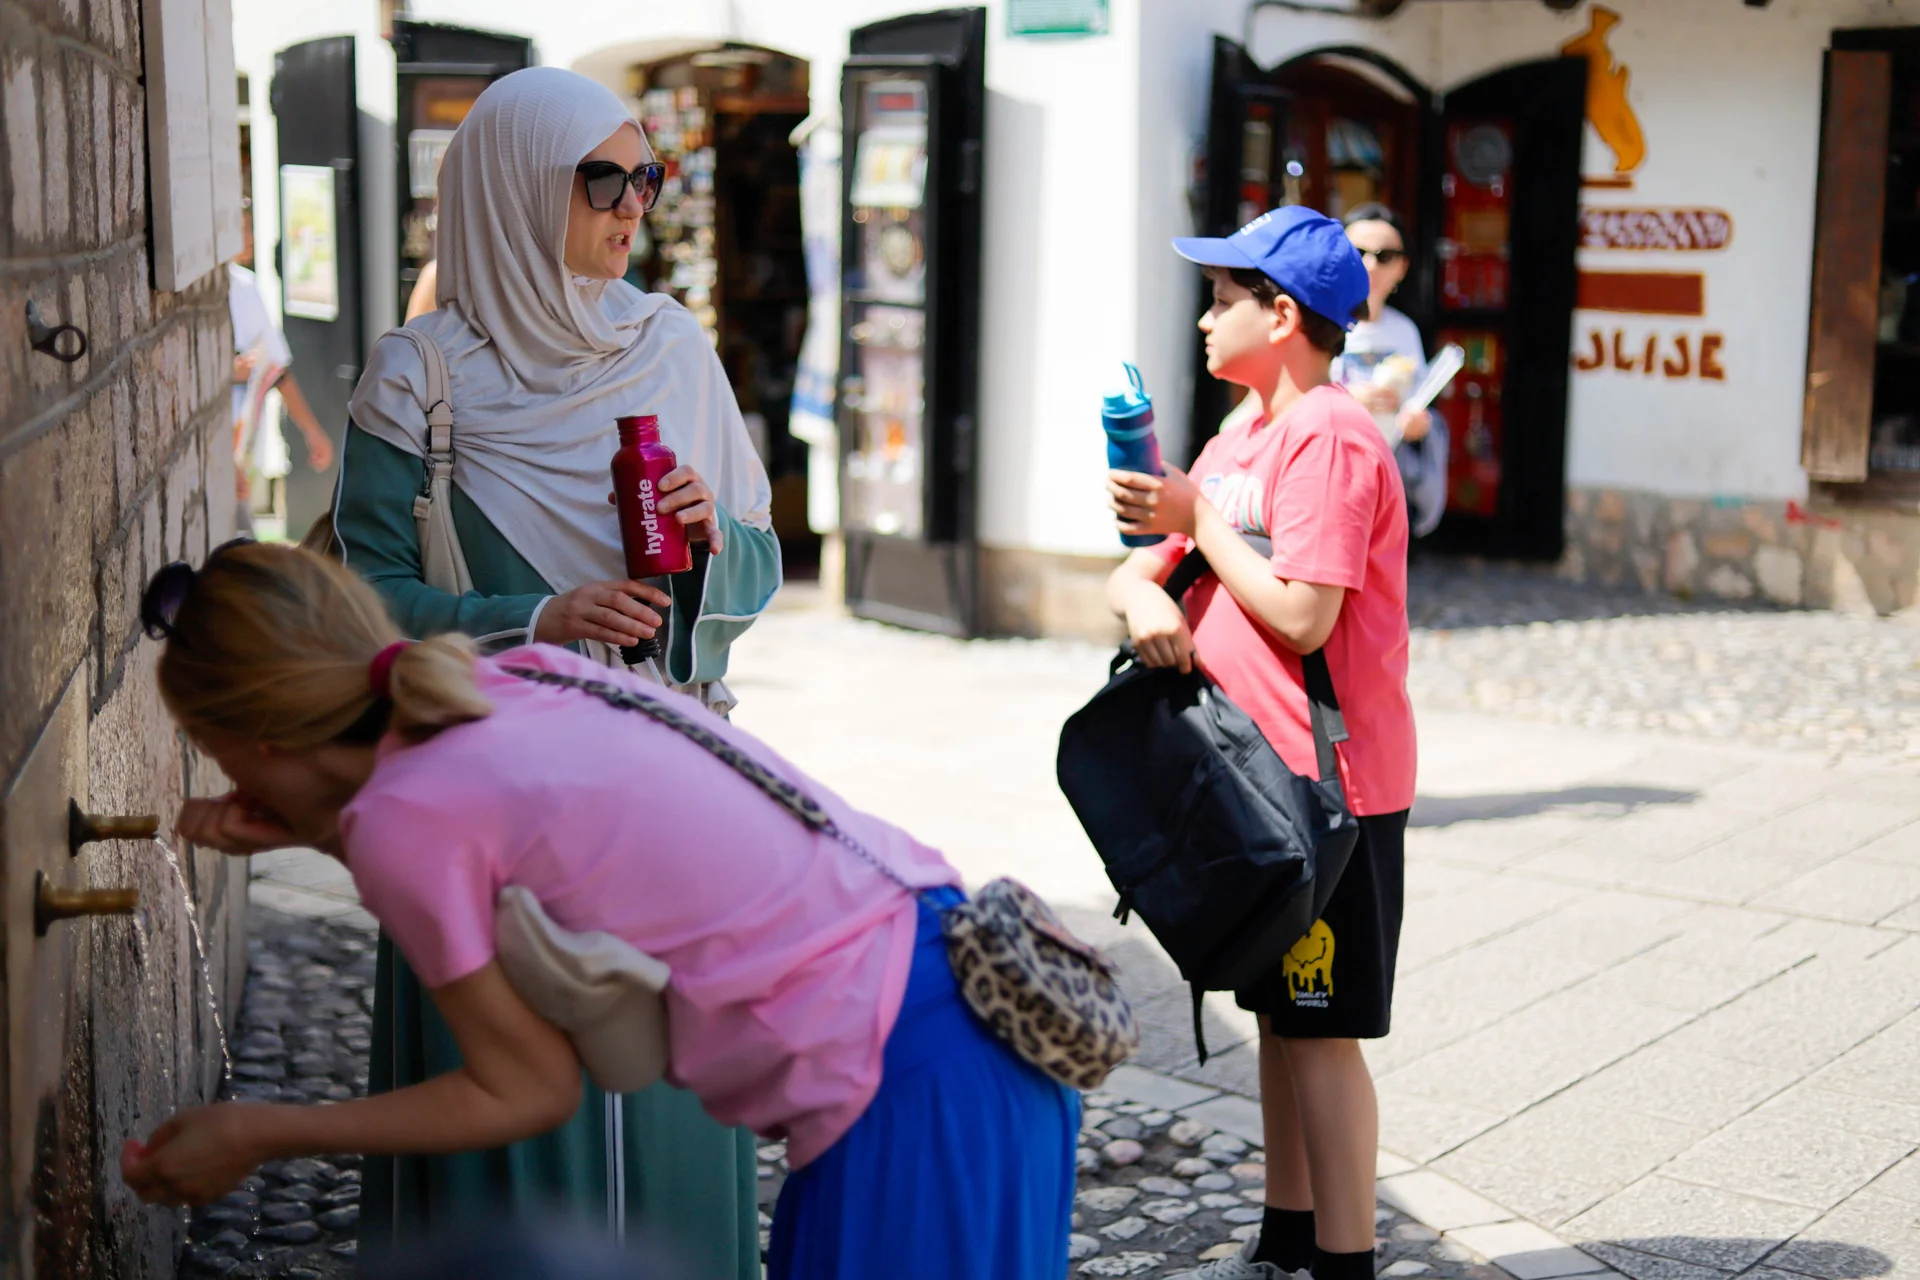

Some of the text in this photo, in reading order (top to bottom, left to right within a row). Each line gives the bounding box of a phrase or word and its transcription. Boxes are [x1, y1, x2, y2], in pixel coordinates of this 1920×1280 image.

[638, 478, 664, 556] hydrate
[1295, 990, 1329, 999] SMILEY
[1295, 999, 1329, 1008] WORLD
